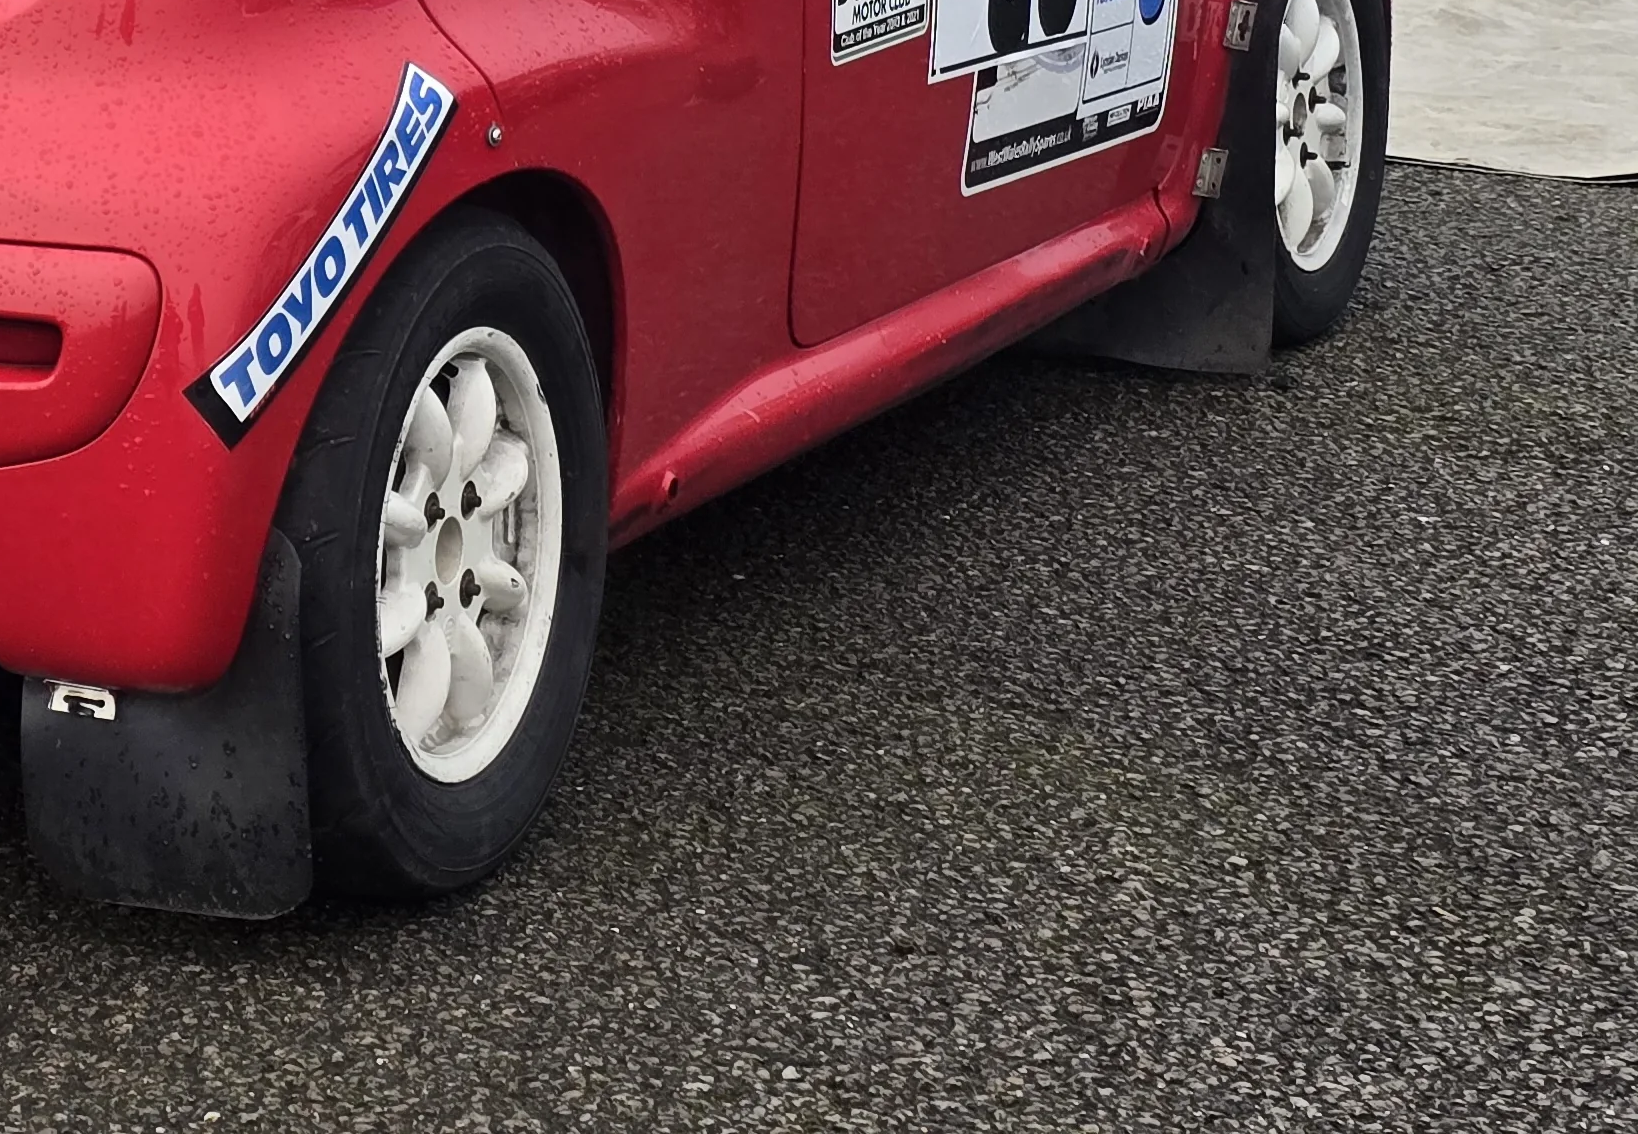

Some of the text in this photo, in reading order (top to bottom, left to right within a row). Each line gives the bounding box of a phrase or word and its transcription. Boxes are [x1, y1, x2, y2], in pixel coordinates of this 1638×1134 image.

[855, 29, 862, 42] of
[219, 71, 443, 409] TOYO TIRES
